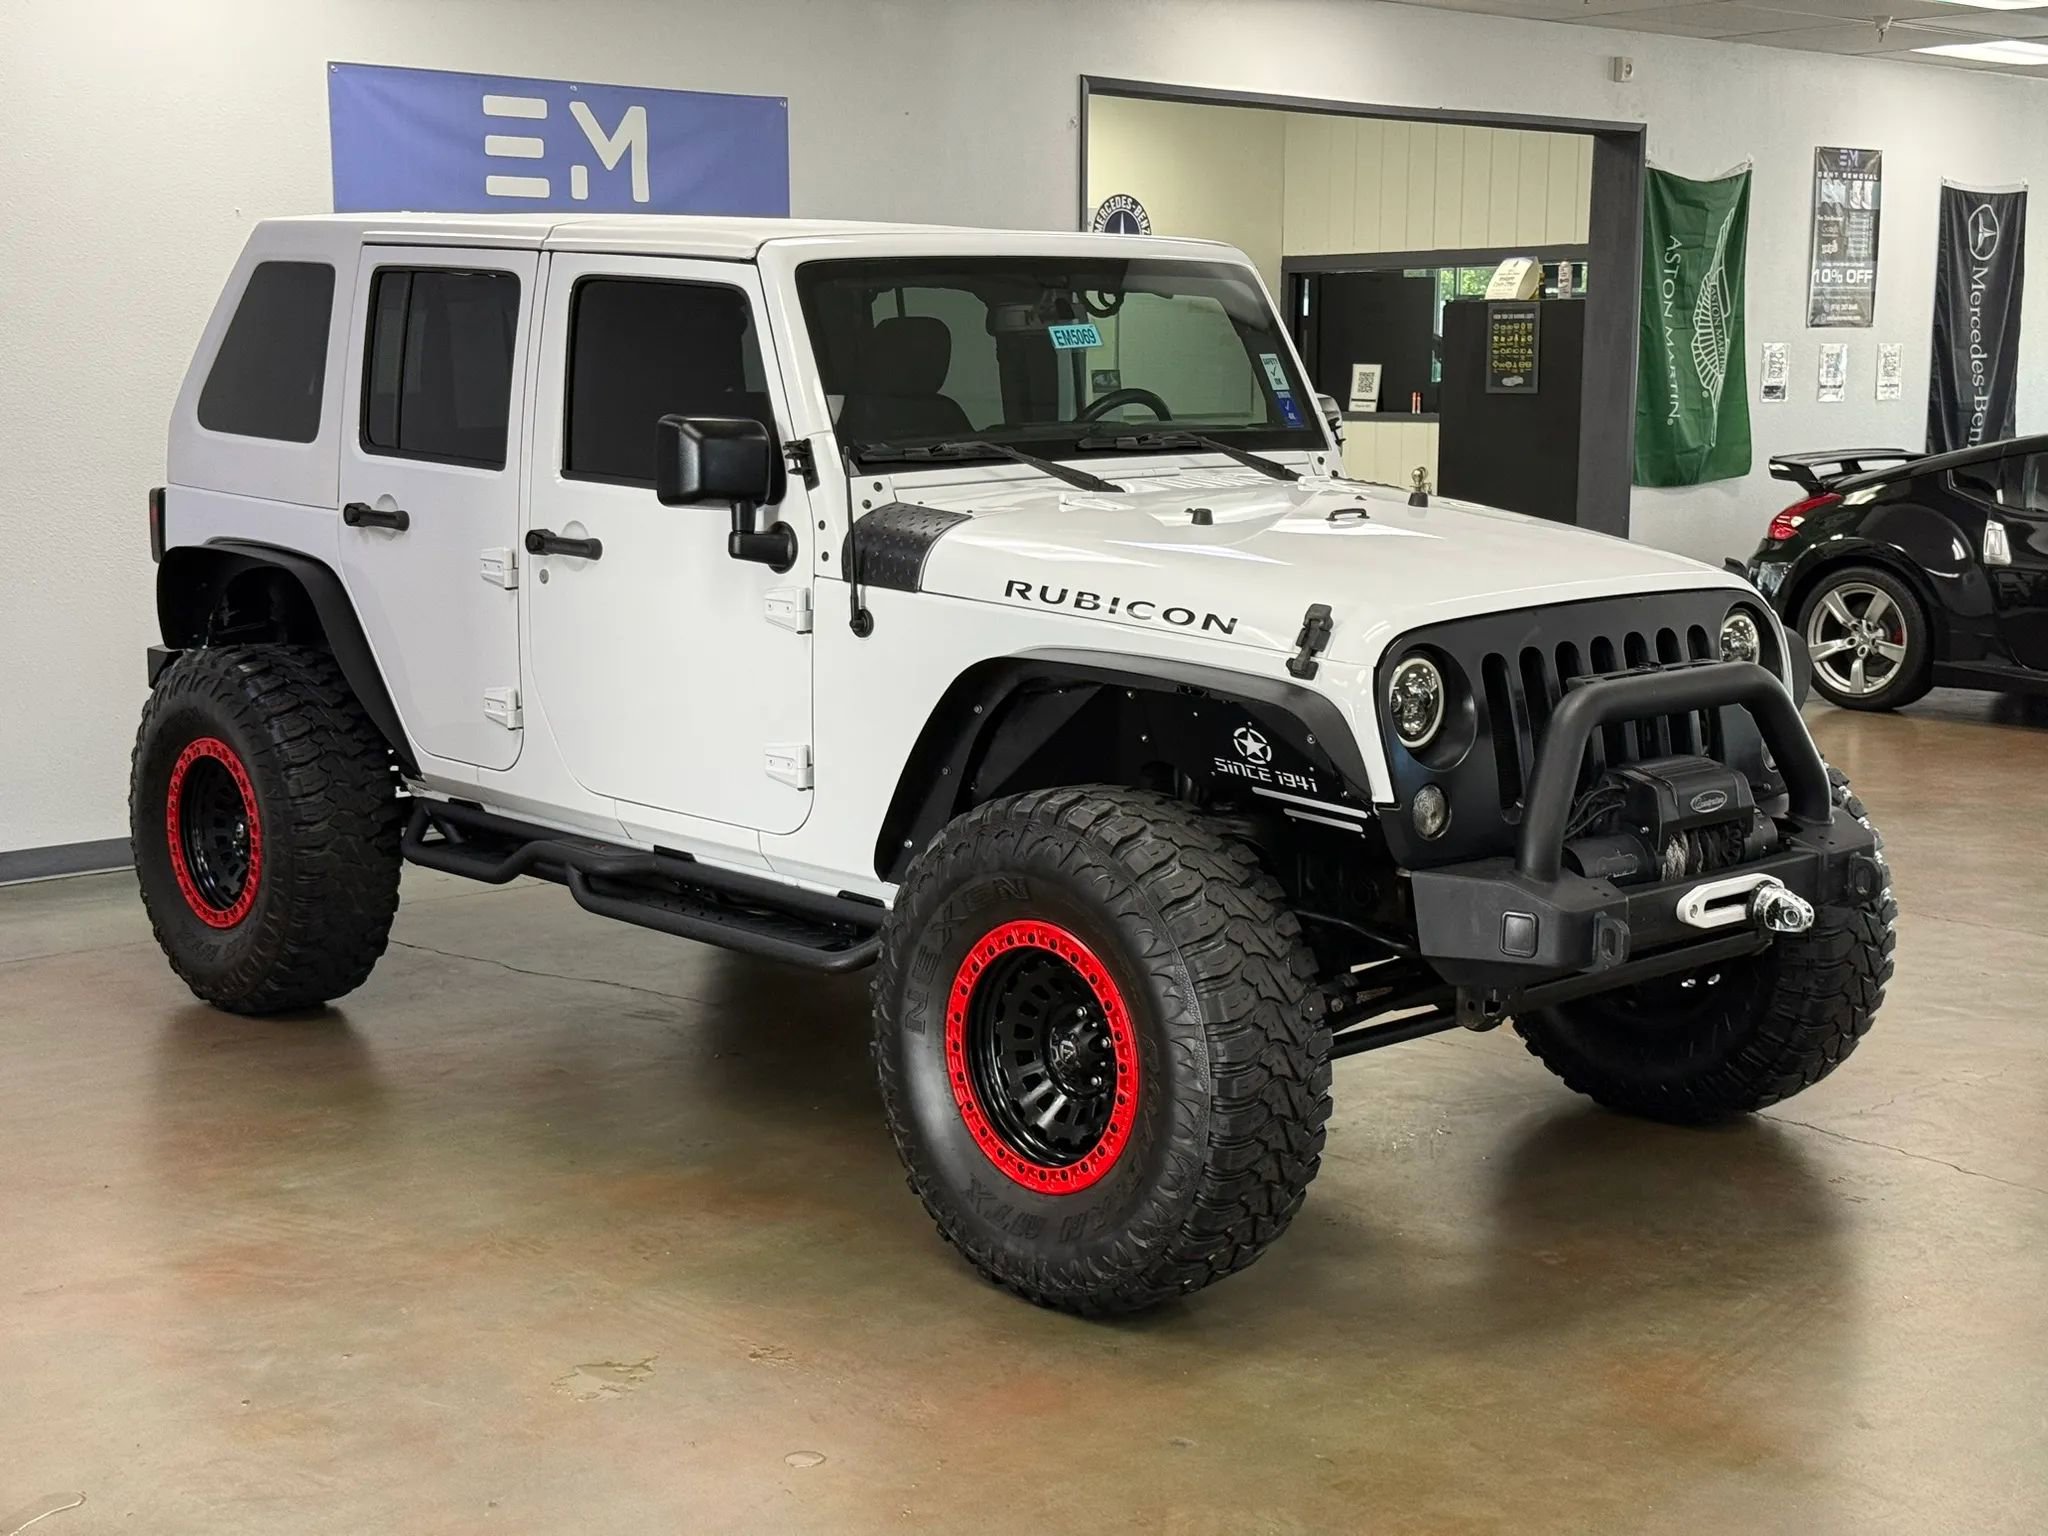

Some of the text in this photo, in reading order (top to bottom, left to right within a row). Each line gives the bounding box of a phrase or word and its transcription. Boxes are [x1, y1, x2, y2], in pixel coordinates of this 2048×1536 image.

[482, 94, 650, 203] EM
[1839, 149, 1859, 168] EM
[1817, 171, 1879, 181] DENT REMOVAL
[1094, 195, 1151, 236] MERCEDES-BENZ
[1813, 268, 1874, 284] 10% OFF
[1053, 328, 1097, 346] EM5069
[1662, 235, 1683, 418] ASTON MARTIN
[1711, 285, 1726, 374] ASTON MARTIN
[1967, 265, 1989, 448] Mercedes-Ben
[1004, 579, 1239, 635] RUBICON
[1275, 770, 1318, 793] 1941
